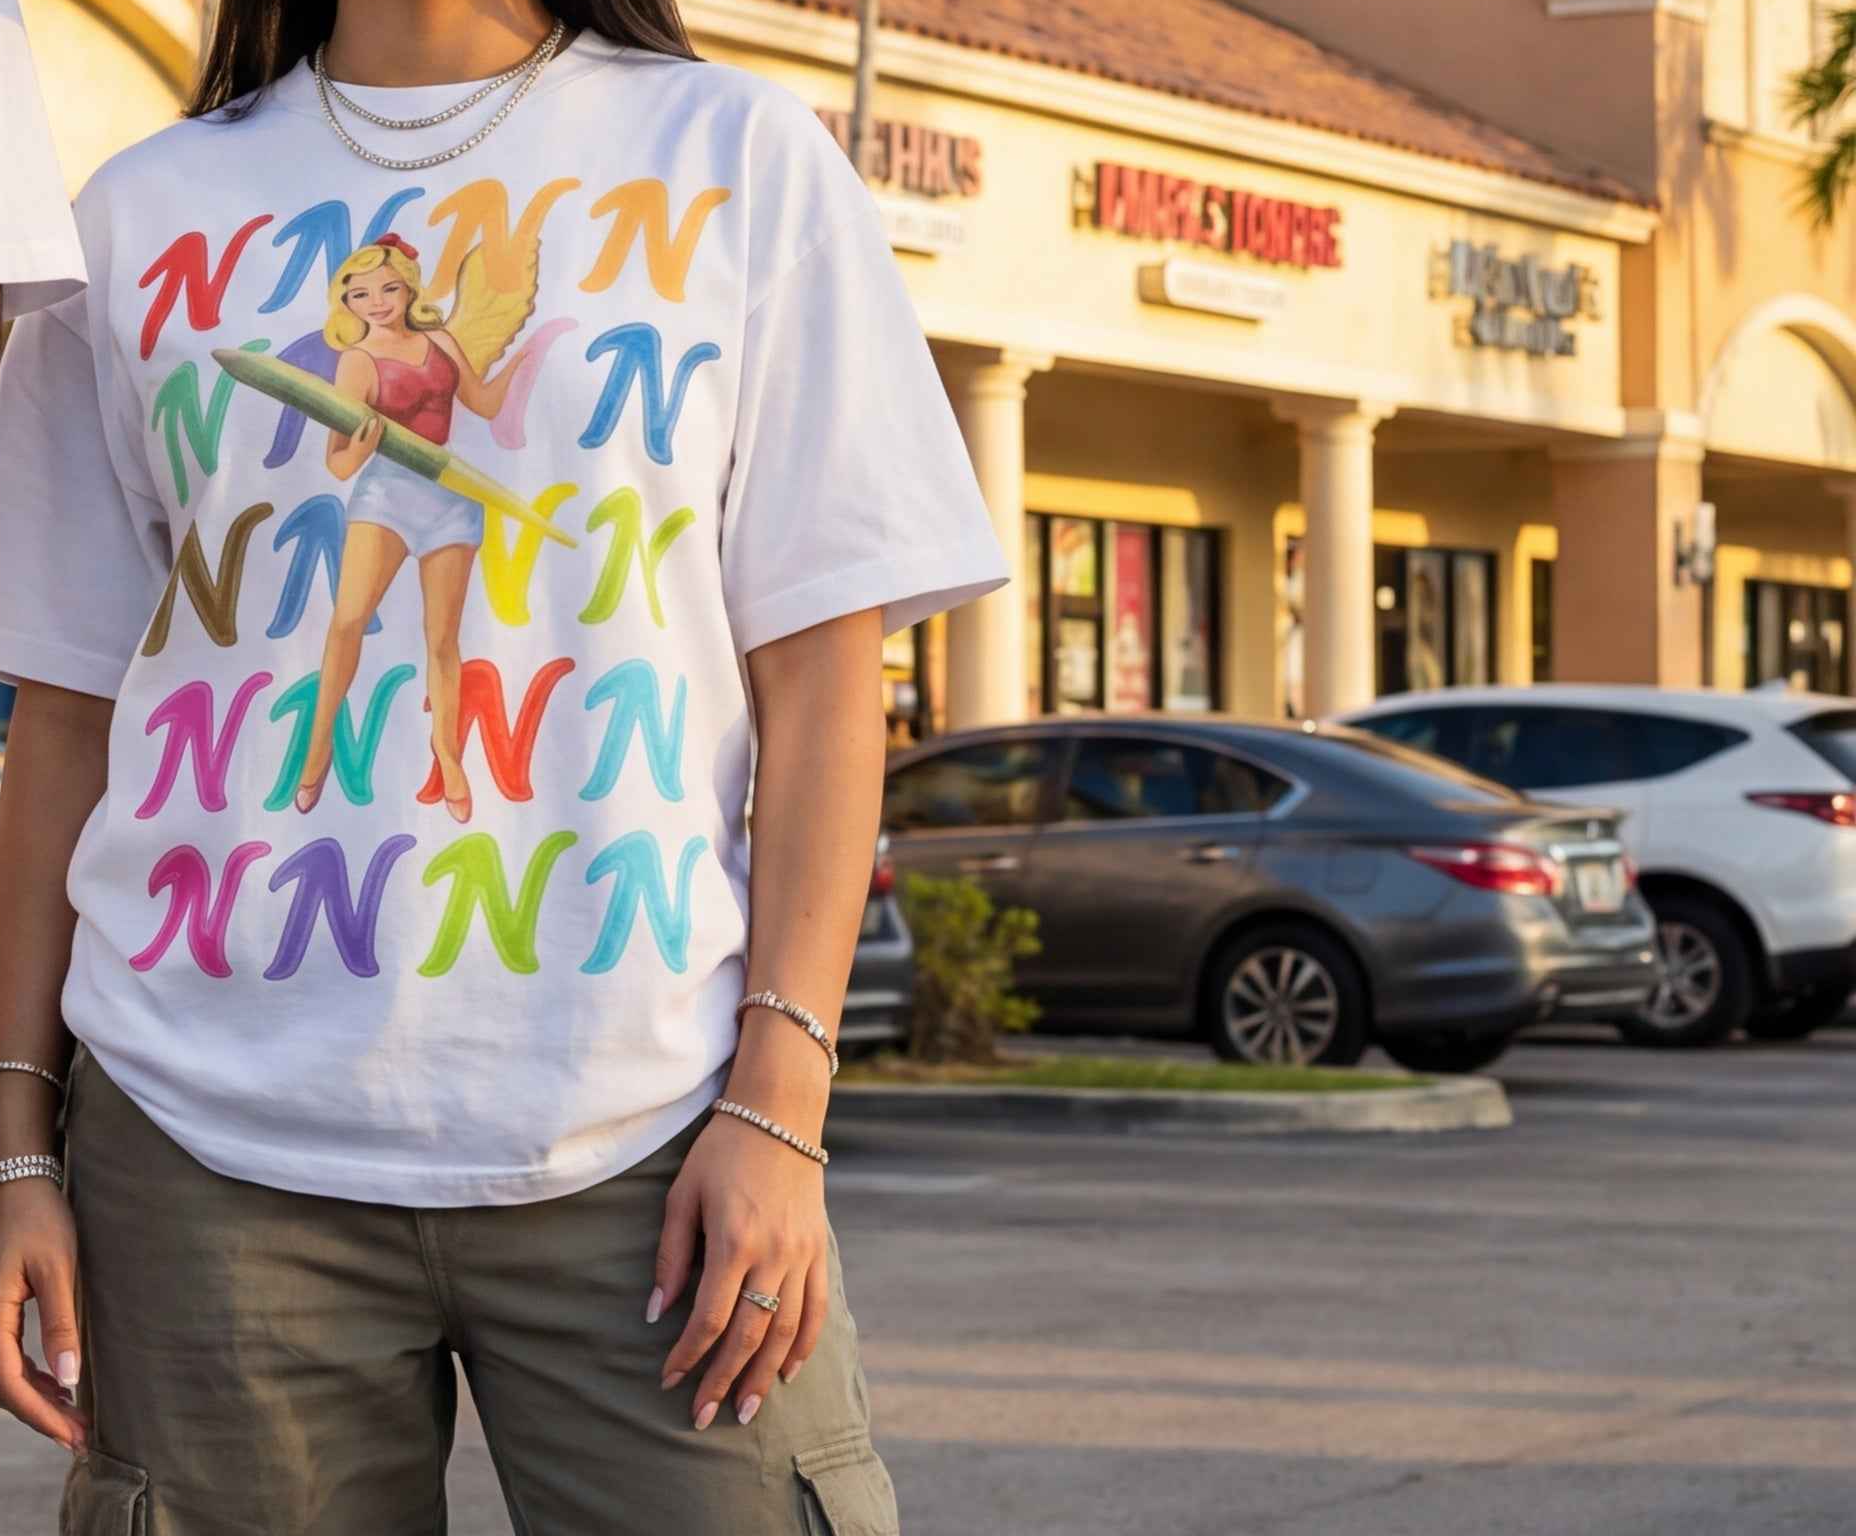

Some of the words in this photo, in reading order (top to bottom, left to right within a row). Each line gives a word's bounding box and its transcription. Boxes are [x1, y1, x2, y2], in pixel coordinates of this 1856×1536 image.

[578, 178, 731, 304] N
[578, 322, 721, 465] N
[140, 501, 274, 657] N
[135, 671, 273, 820] N
[578, 658, 687, 802] N
[129, 841, 271, 979] N
[263, 834, 417, 981] N
[417, 830, 578, 977] N
[578, 829, 707, 976] N
